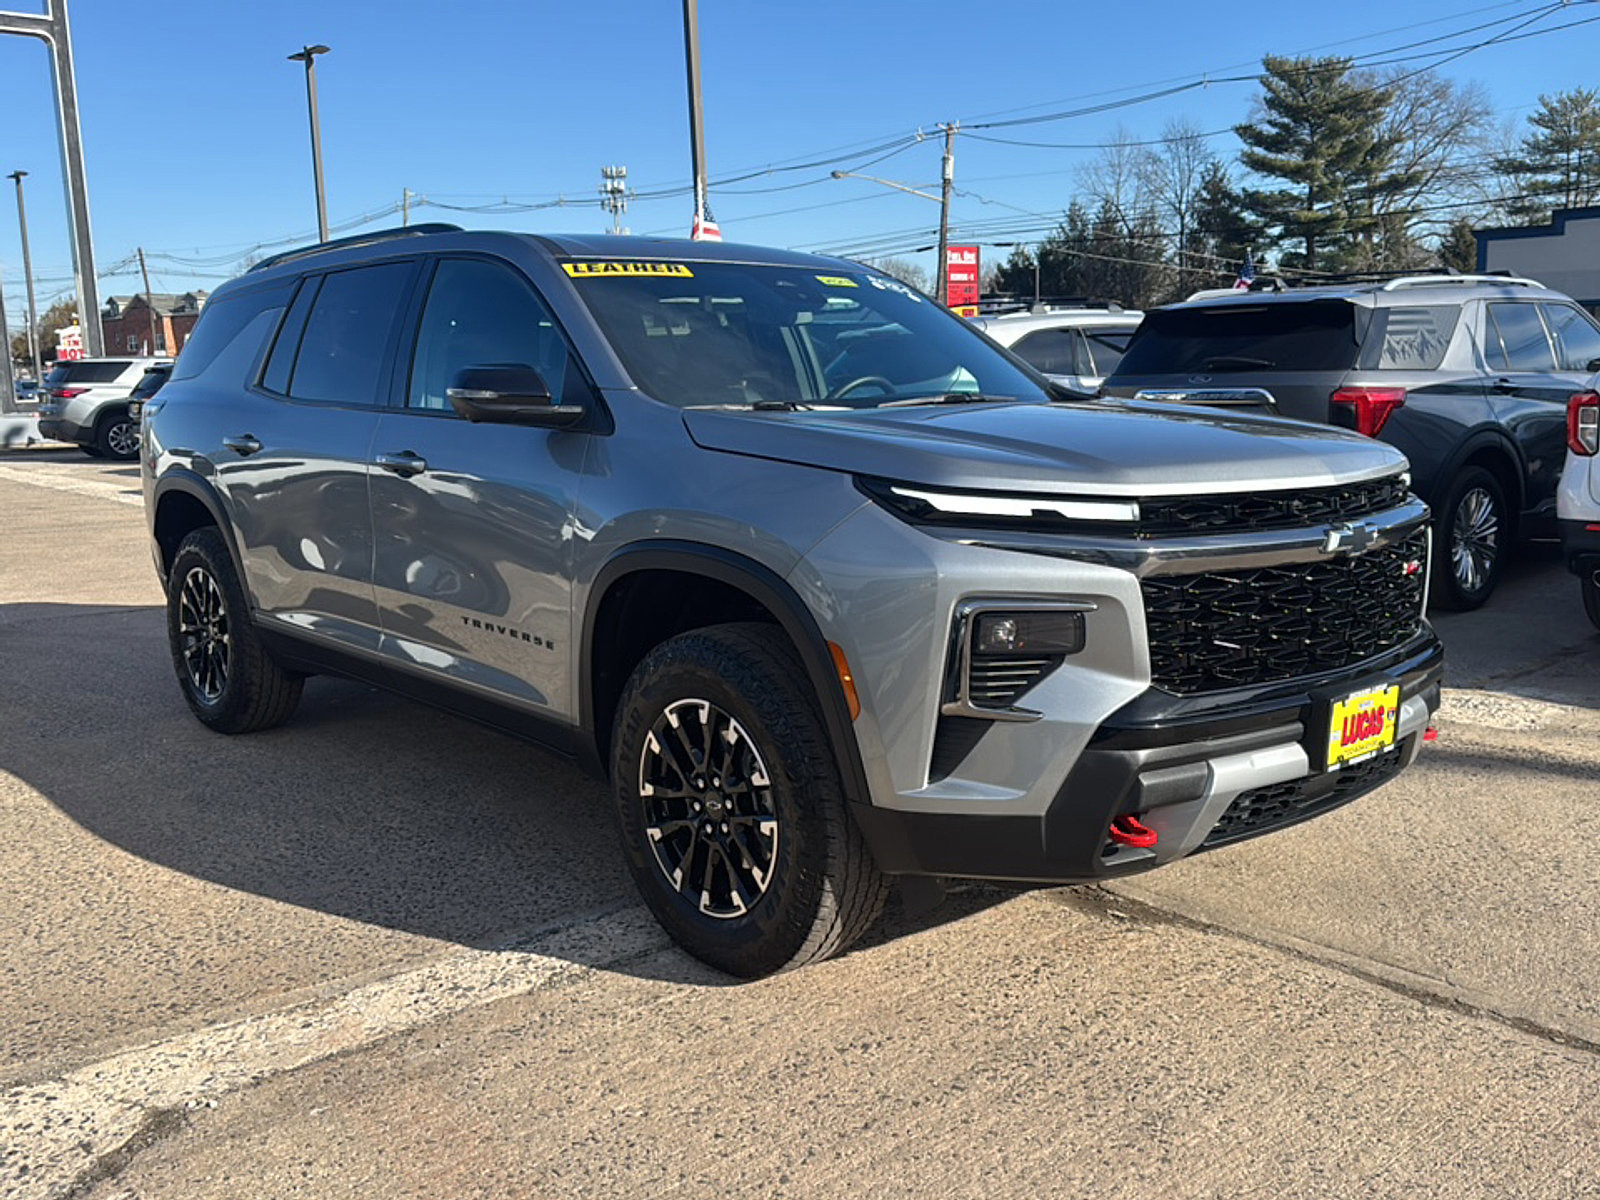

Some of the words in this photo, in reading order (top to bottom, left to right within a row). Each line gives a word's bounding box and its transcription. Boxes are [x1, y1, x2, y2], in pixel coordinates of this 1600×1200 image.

[571, 262, 684, 274] LEATHER
[461, 615, 554, 651] TRAVERSE
[1340, 704, 1385, 747] LUCAS
